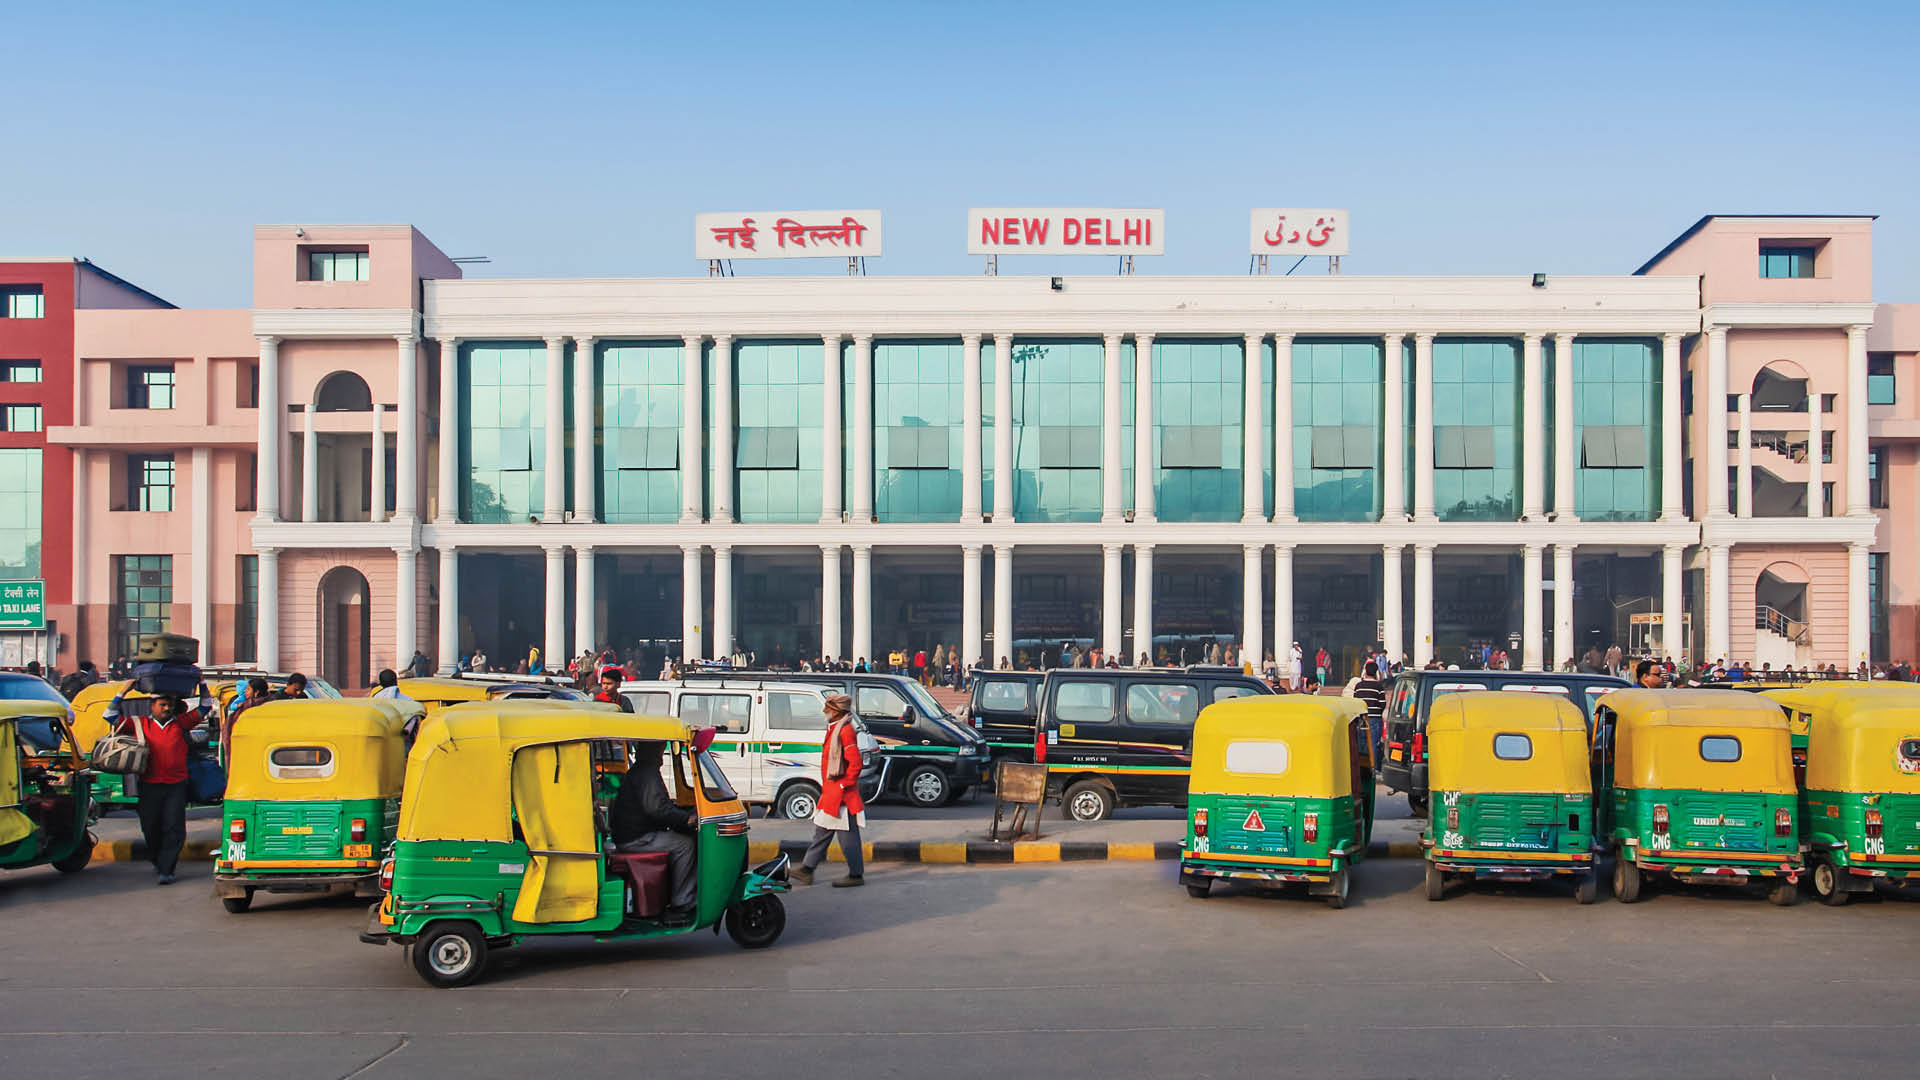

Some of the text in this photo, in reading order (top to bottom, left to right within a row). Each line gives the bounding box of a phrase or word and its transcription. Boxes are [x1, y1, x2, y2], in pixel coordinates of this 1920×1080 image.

[710, 216, 868, 252] नई दिल्ली
[981, 217, 1151, 245] NEW DELHI
[3, 604, 19, 613] TAXI
[21, 604, 40, 613] LANE
[1193, 836, 1210, 853] CNG
[1652, 833, 1671, 850] CNG
[1864, 838, 1884, 855] CNG
[227, 844, 246, 861] CNG
